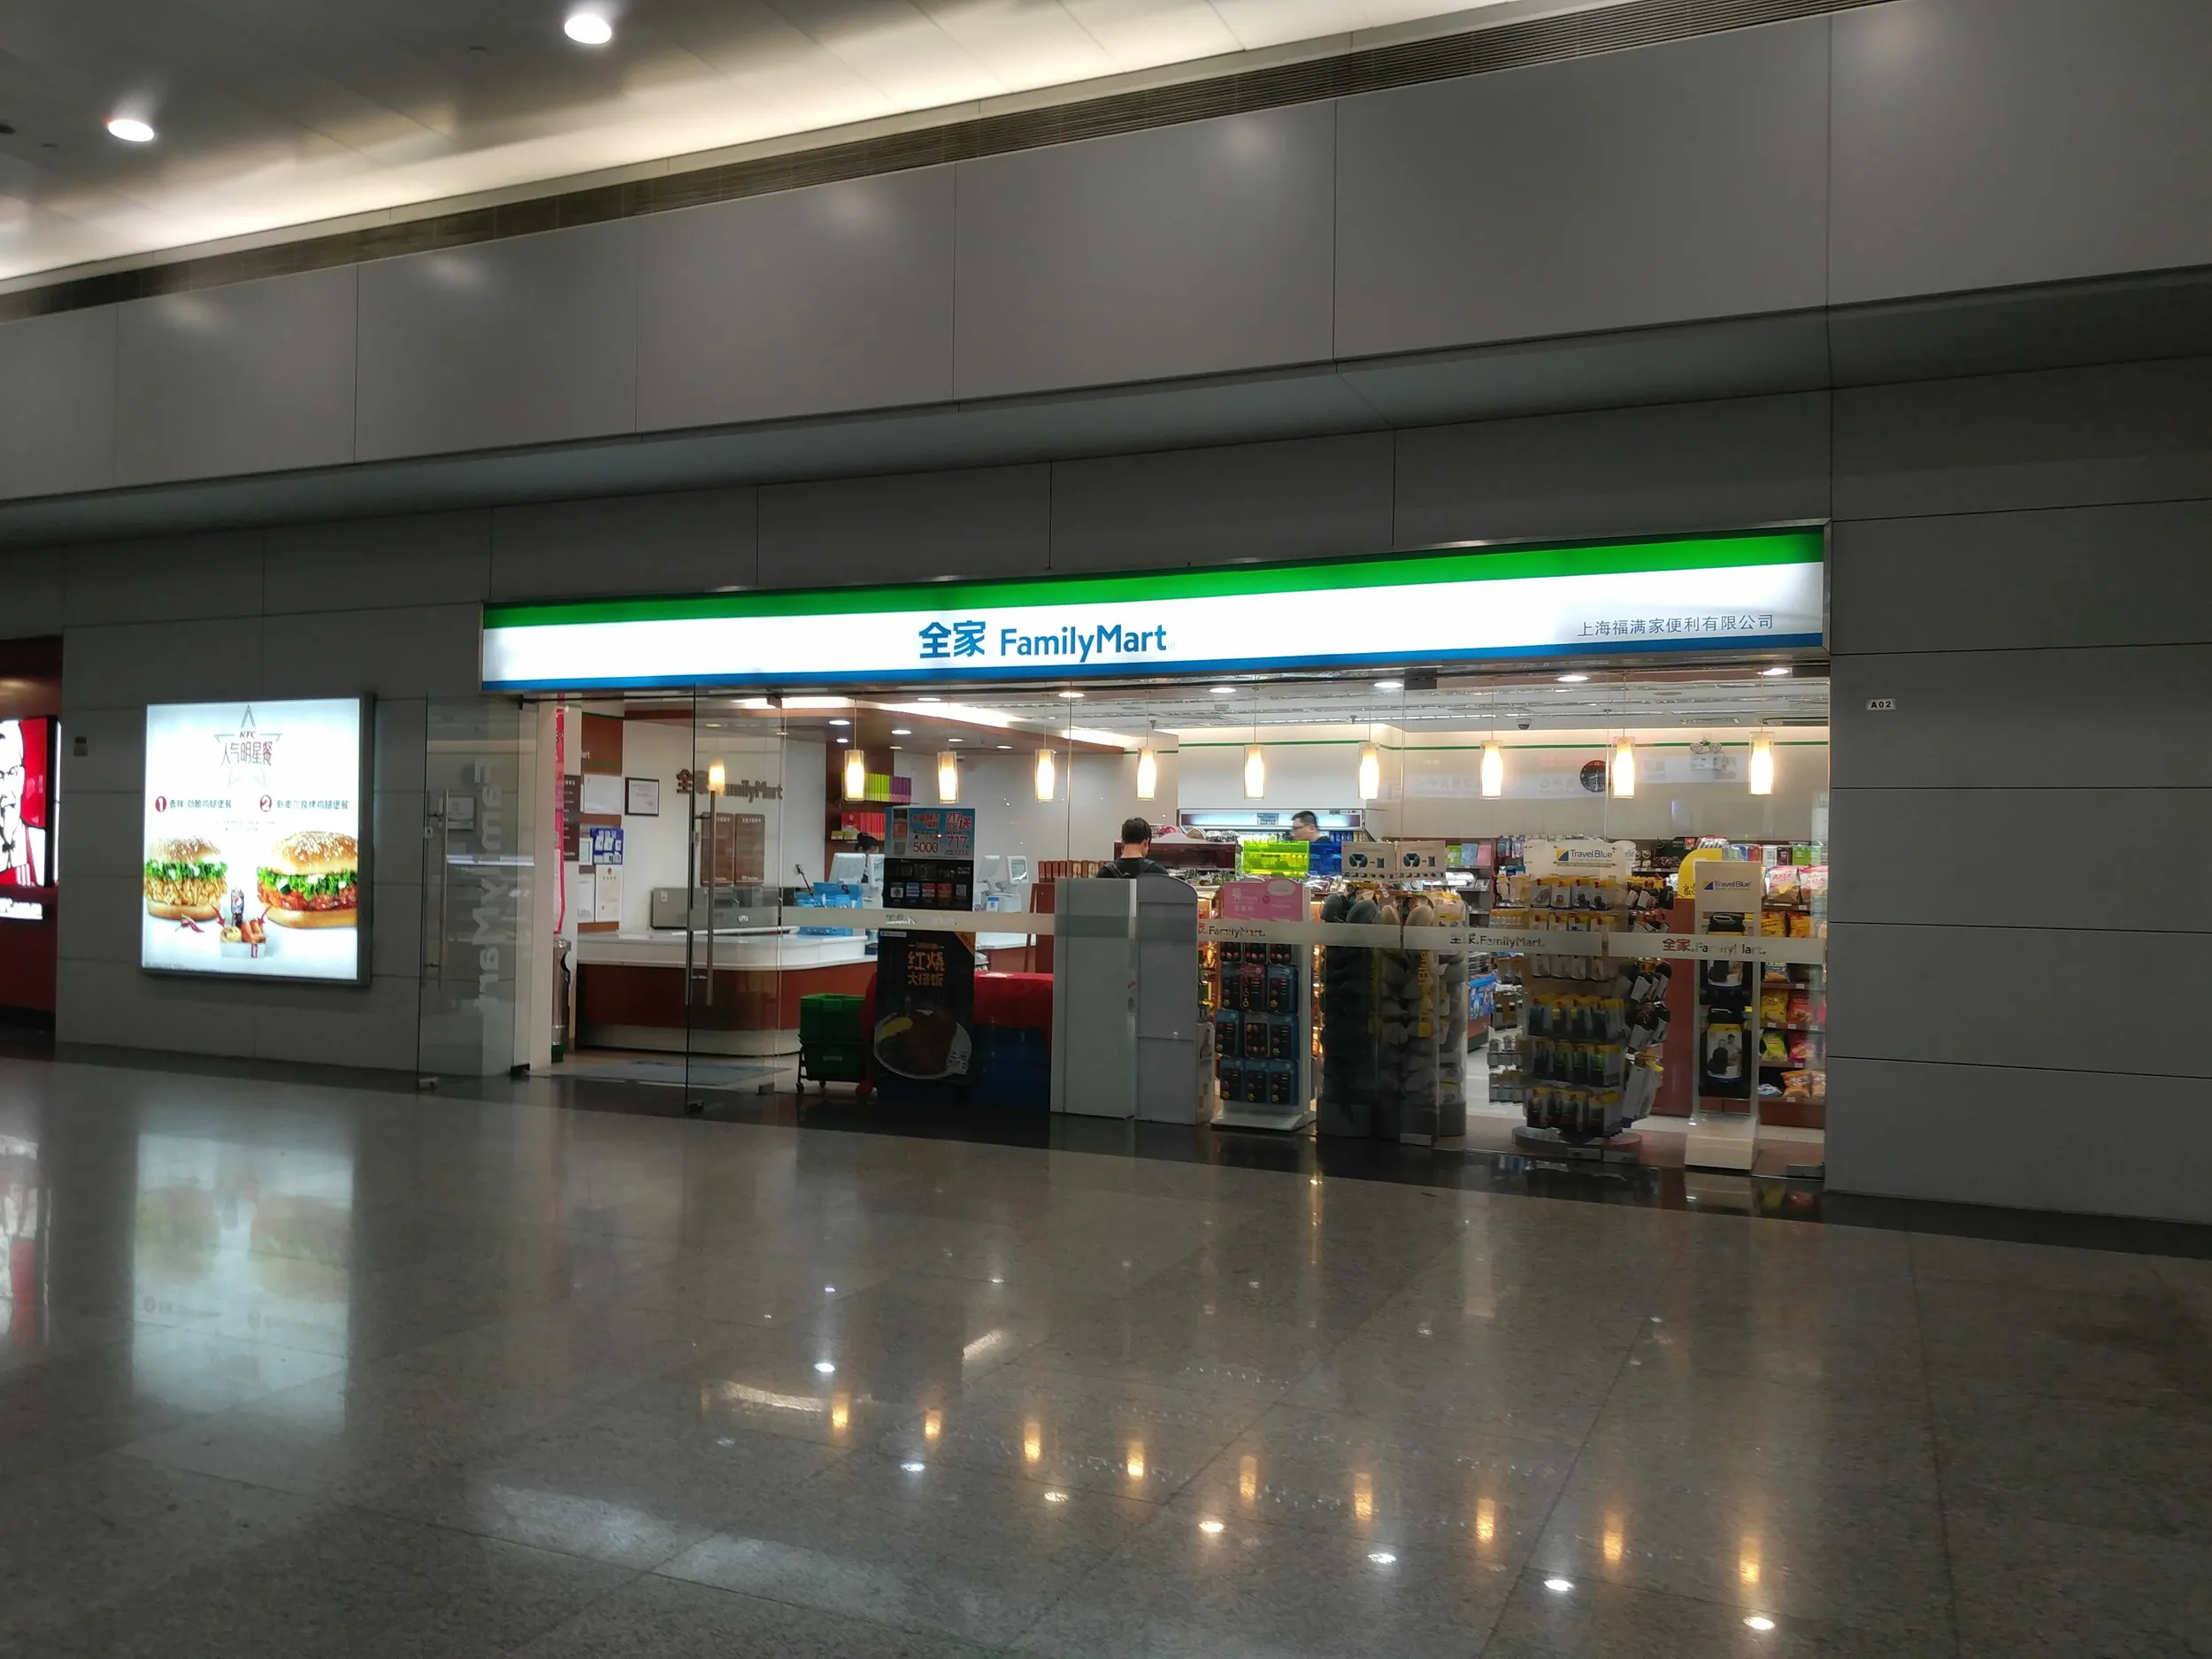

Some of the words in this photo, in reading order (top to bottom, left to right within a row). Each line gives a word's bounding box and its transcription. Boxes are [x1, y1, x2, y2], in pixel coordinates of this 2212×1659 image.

[1577, 613, 1774, 637] 上海福满家便利有限公司
[918, 620, 986, 659] 全家
[1001, 624, 1167, 663] FamilyMart
[221, 741, 273, 767] 人气明星餐
[913, 841, 938, 853] 5000
[947, 835, 967, 849] 717
[1570, 849, 1594, 858] Travel
[1594, 849, 1612, 858] Blue
[1663, 938, 1691, 952] 全家
[907, 950, 946, 972] 红烧
